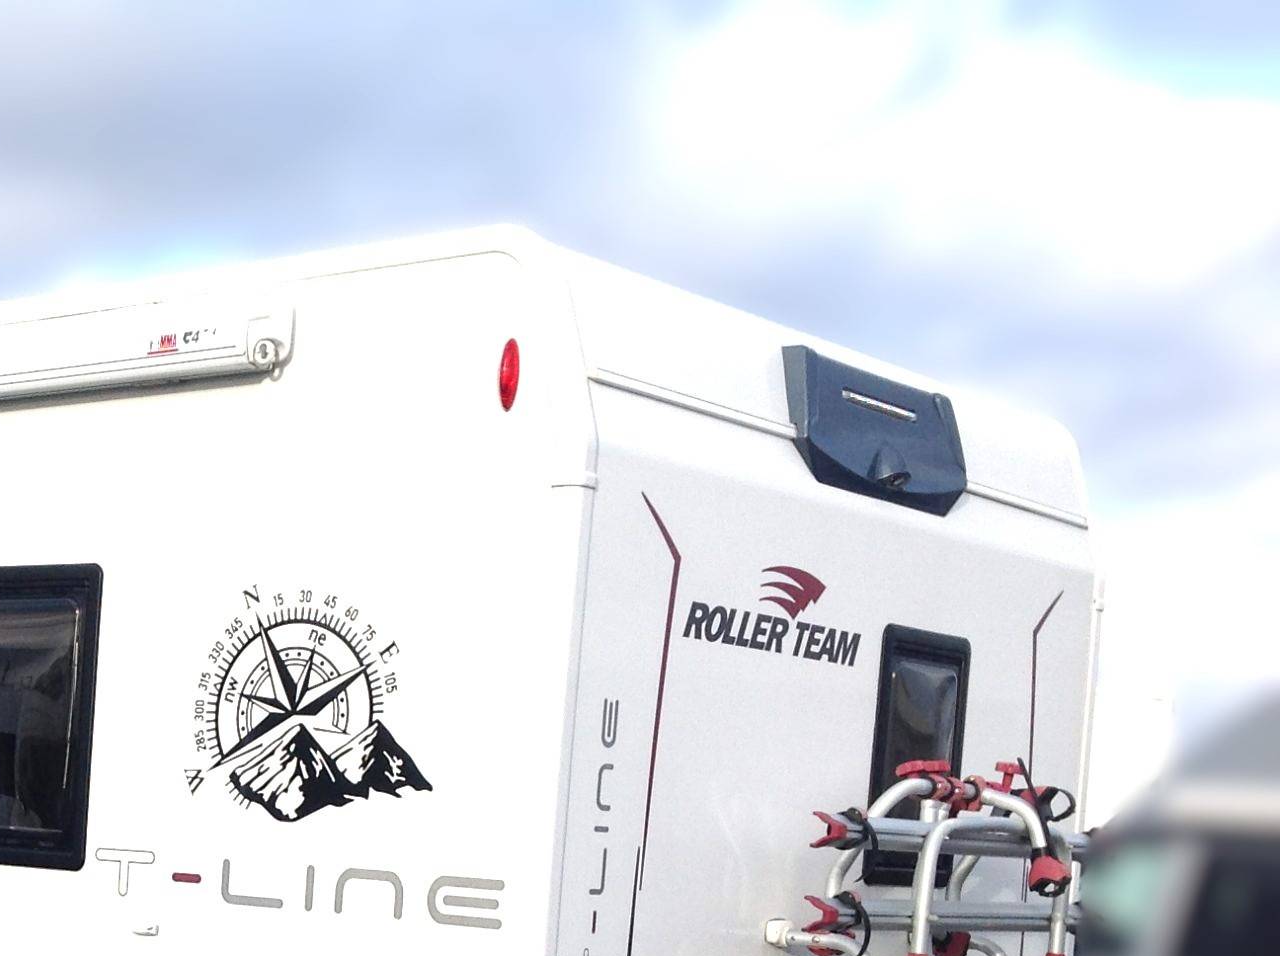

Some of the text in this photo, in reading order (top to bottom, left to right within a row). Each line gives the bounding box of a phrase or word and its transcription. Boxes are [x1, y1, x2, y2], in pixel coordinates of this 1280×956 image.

[242, 583, 261, 610] N
[273, 592, 284, 607] 15
[299, 589, 313, 603] 30
[323, 594, 338, 609] 45
[344, 606, 359, 621] 60
[224, 617, 243, 640] 345
[362, 624, 377, 641] 75
[682, 600, 862, 667] ROLLER TEAM
[208, 641, 225, 664] 330
[378, 640, 400, 664] E
[198, 672, 212, 692] 315
[384, 672, 398, 694] 105
[194, 699, 205, 721] 300
[194, 729, 207, 752] 285
[183, 768, 205, 797] W
[95, 847, 506, 930] T-LINE
